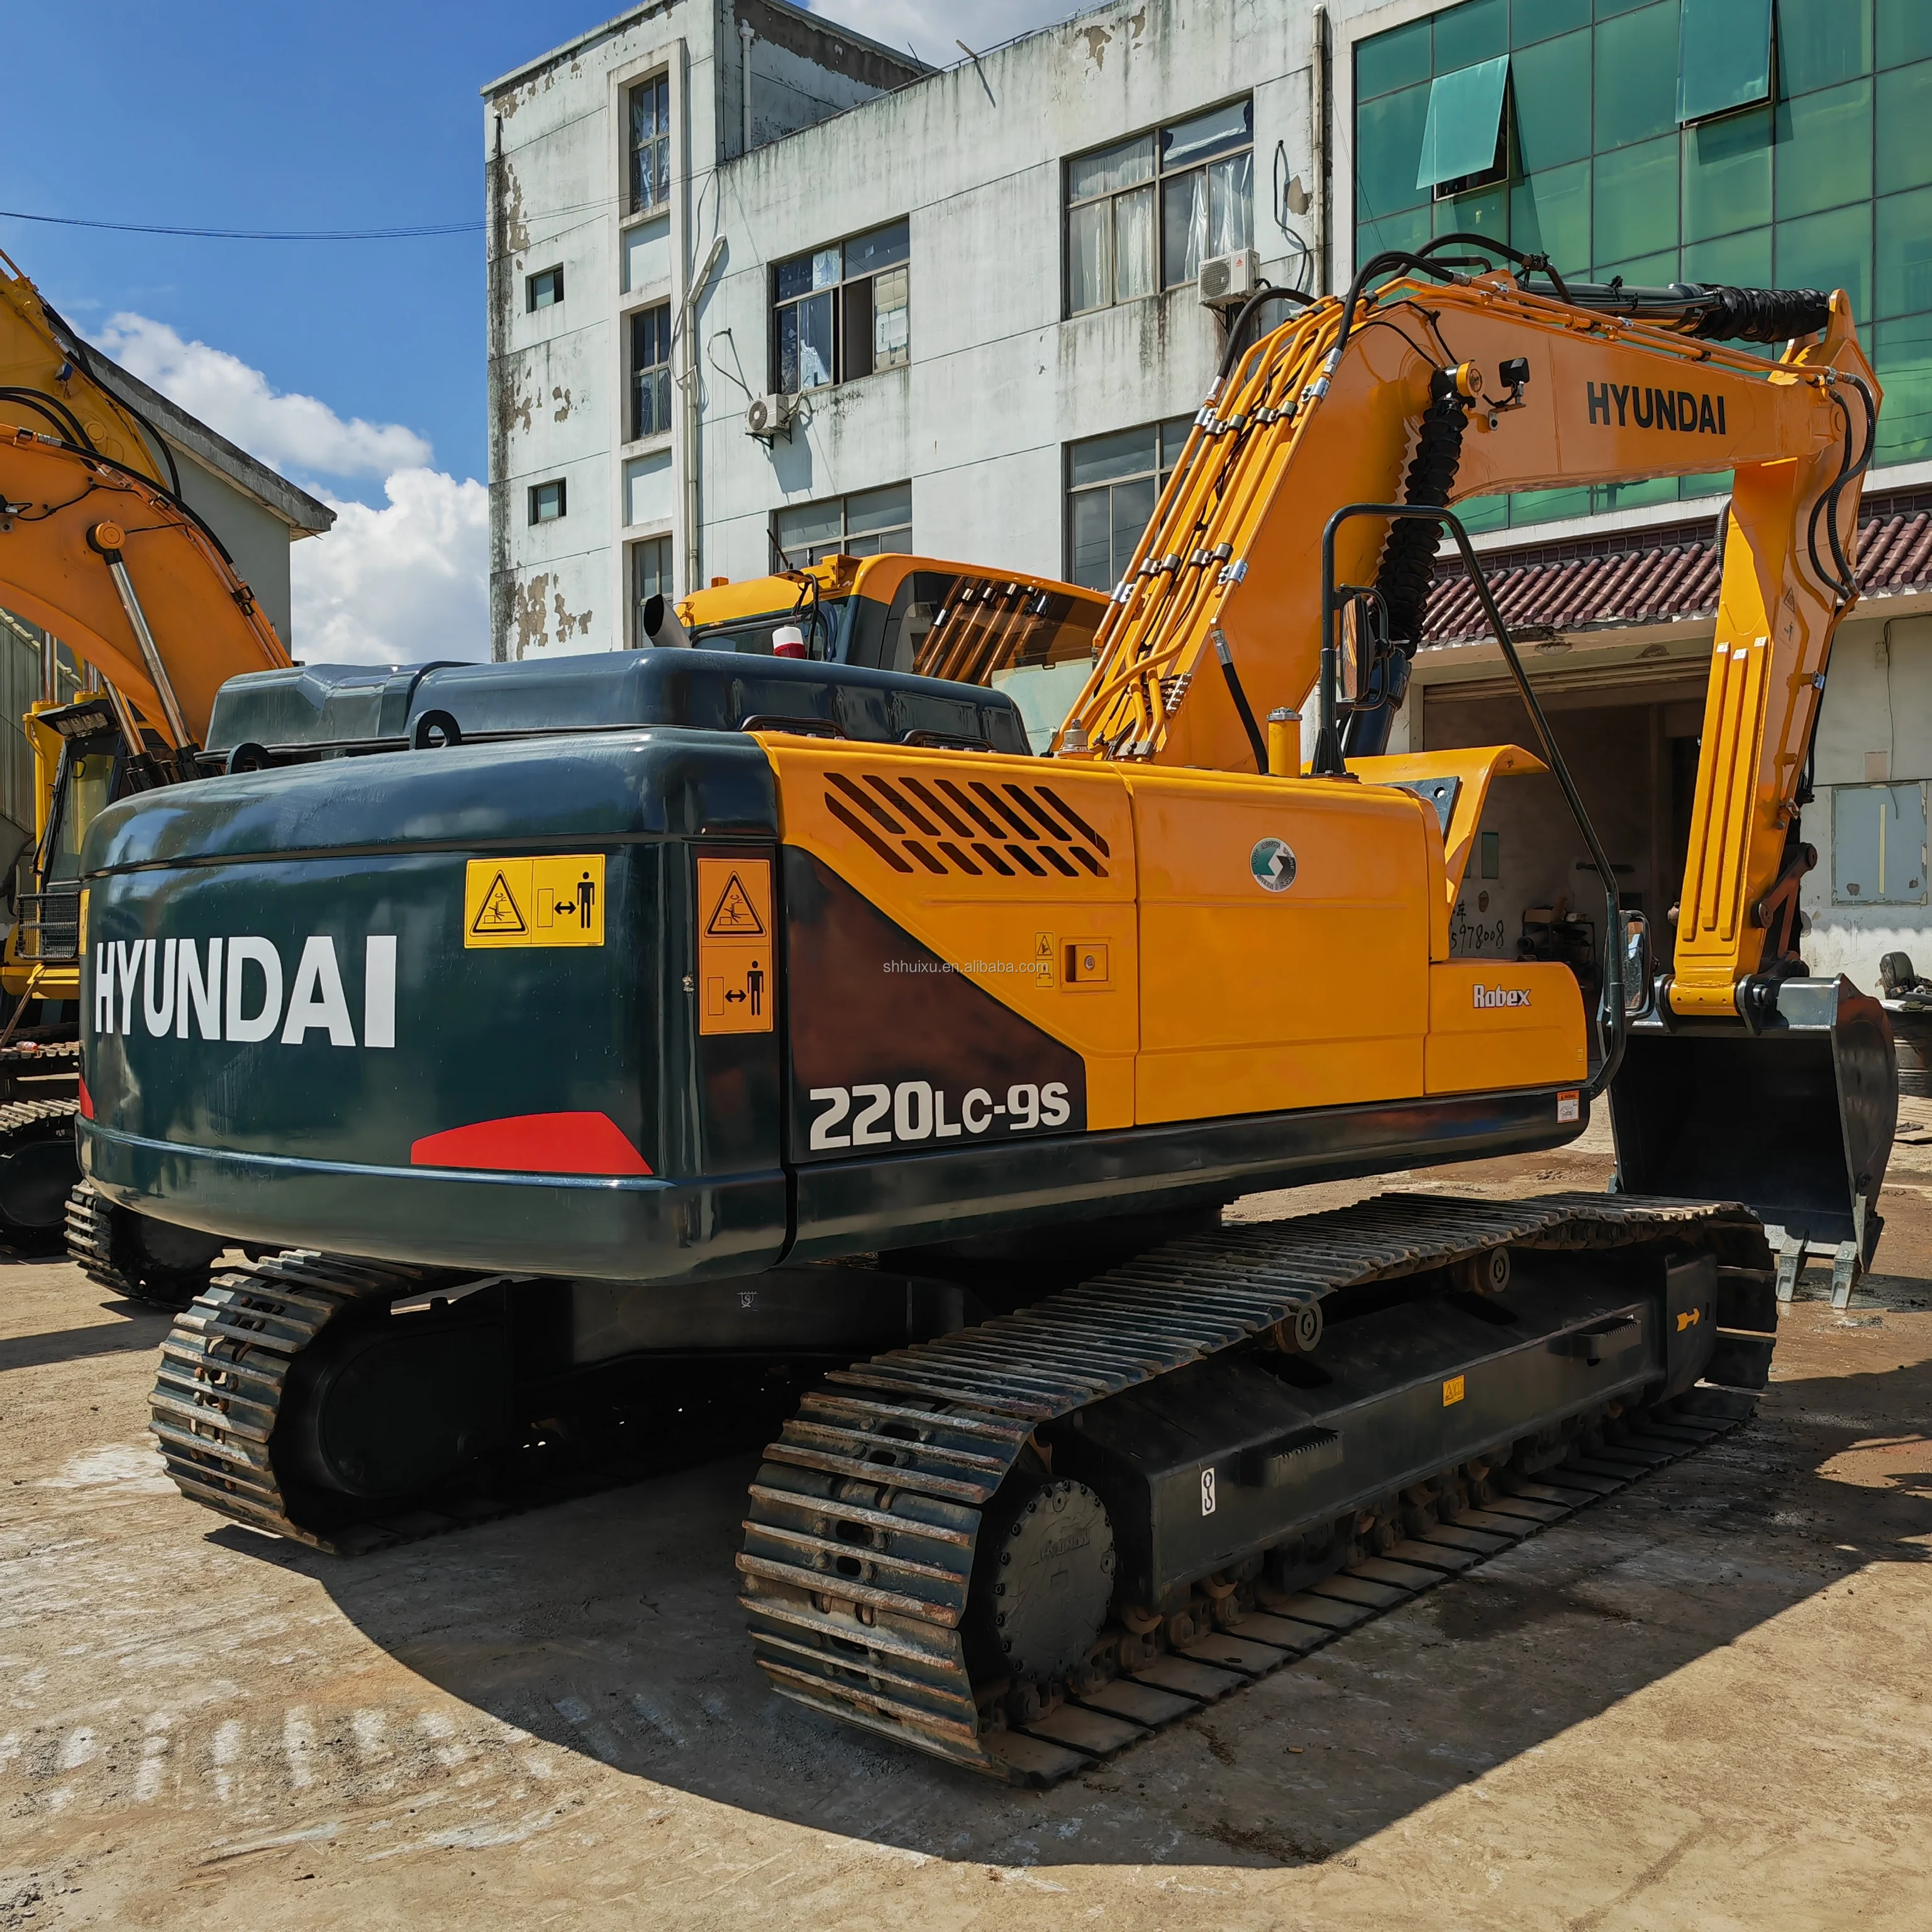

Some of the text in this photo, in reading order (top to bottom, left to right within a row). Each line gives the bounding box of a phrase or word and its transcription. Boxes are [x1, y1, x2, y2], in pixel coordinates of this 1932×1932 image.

[1587, 381, 1726, 435] HYUNDAI
[95, 935, 397, 1048] HYUNDAI
[810, 1080, 1070, 1150] 220LC-9S
